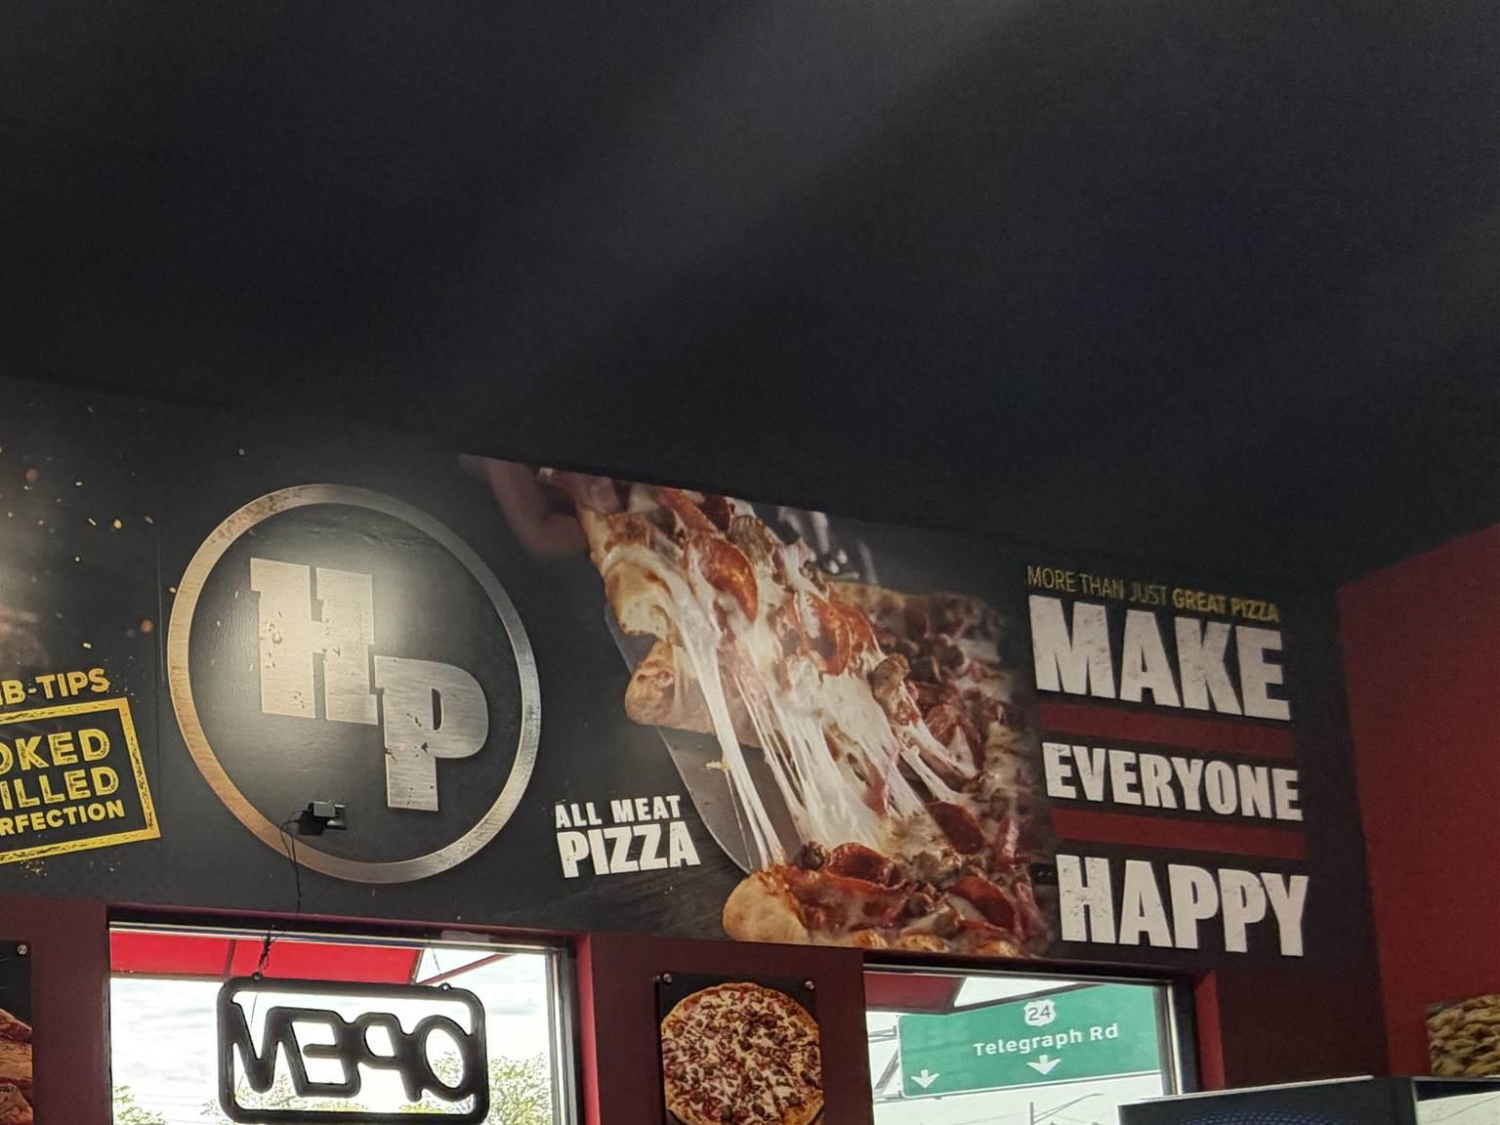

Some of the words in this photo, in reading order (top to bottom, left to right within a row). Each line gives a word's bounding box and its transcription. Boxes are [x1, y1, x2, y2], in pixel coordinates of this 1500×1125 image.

[1027, 565, 1076, 593] MORE
[1079, 573, 1124, 599] THAN
[1130, 582, 1167, 606] JUST
[1172, 588, 1227, 614] GREAT
[1231, 597, 1280, 622] PIZZA
[1028, 594, 1291, 721] MAKE
[1042, 742, 1303, 821] EVERYONE
[555, 802, 603, 828] ALL
[610, 795, 681, 823] MEAT
[557, 821, 701, 878] PIZZA
[1055, 854, 1309, 957] HAPPY
[973, 1028, 1082, 1057] Telegraph
[1090, 1023, 1119, 1041] Rd
[1028, 1003, 1051, 1021] 24
